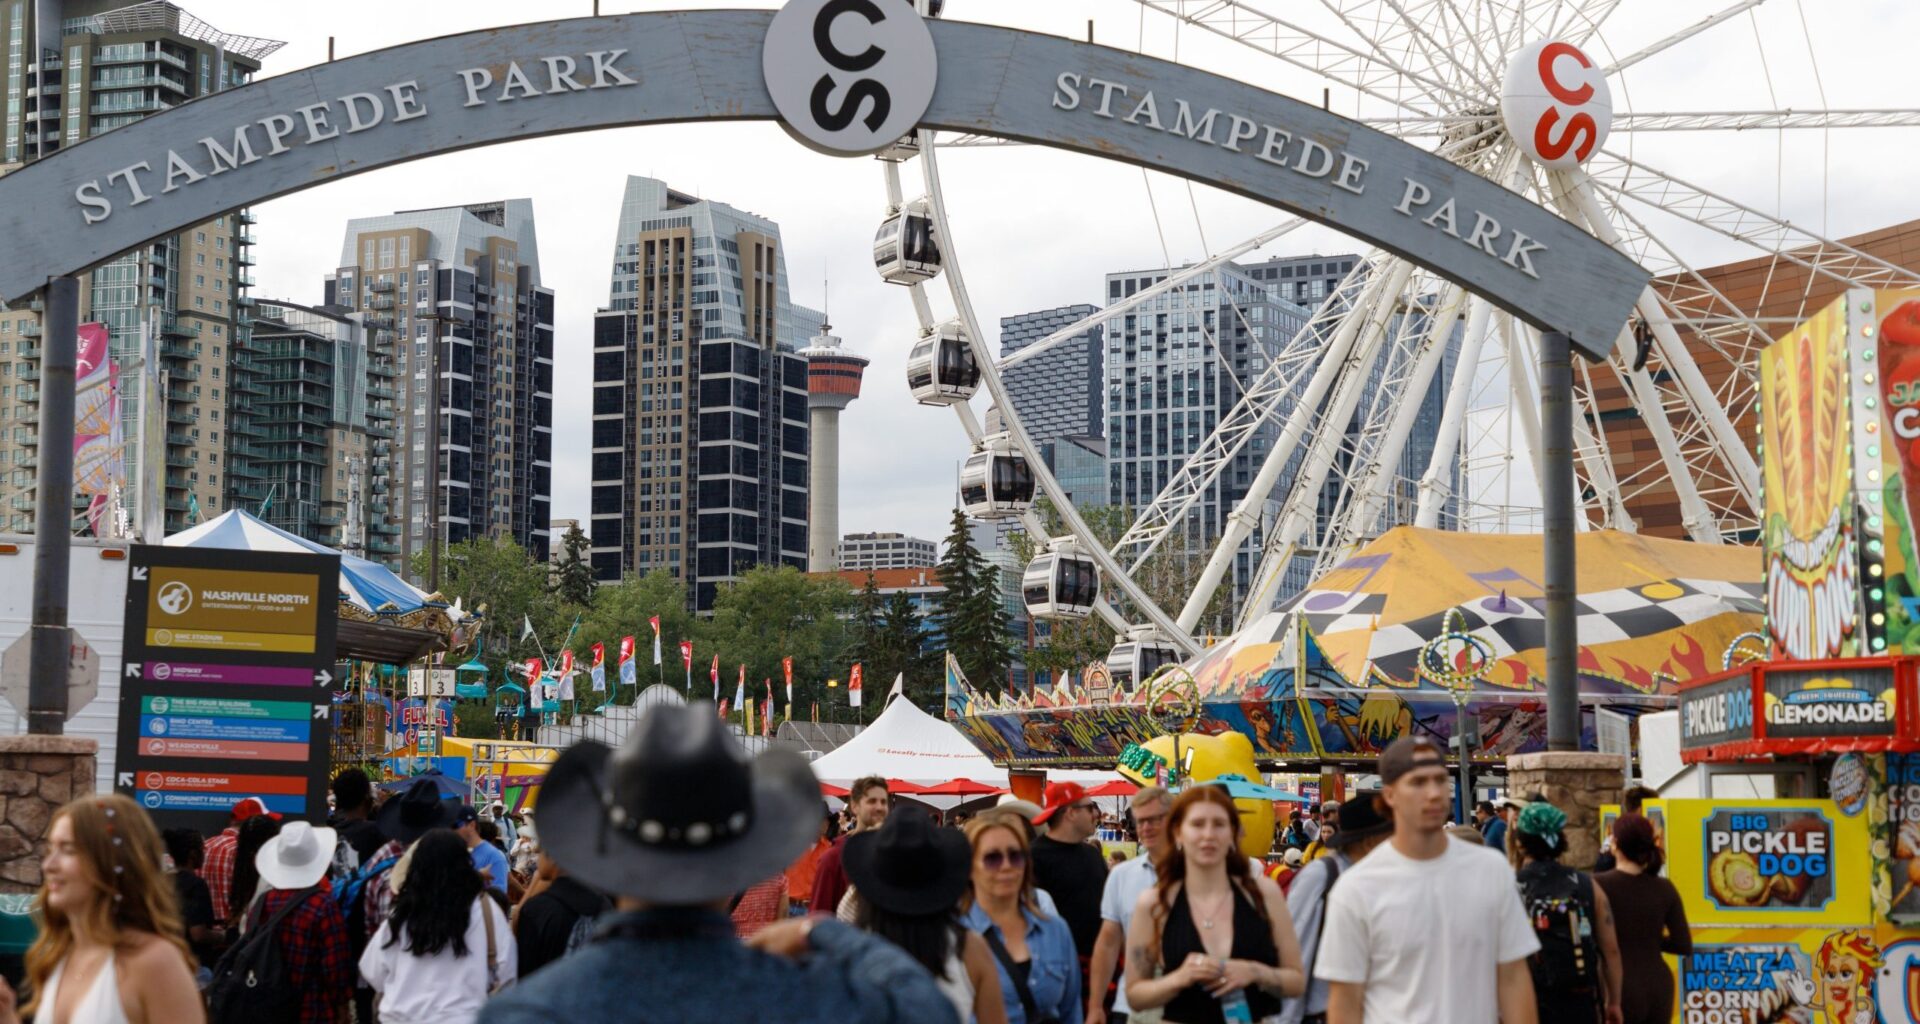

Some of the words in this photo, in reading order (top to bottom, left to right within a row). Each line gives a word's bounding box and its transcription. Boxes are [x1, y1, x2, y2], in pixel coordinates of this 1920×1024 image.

[74, 80, 427, 225] STAMPEDE
[456, 49, 639, 108] PARK
[1052, 71, 1371, 195] STAMPEDE
[1393, 177, 1549, 281] PARK
[202, 590, 266, 603] NASHVILLE
[268, 593, 310, 605] NORTH
[173, 666, 203, 674] MIDWAY
[413, 681, 419, 695] 3
[437, 681, 445, 695] 3
[171, 698, 185, 706] THE
[1688, 693, 1727, 737] PICKLE
[1728, 687, 1753, 731] DOG
[1773, 702, 1886, 725] LEMONADE
[187, 718, 213, 726] CENTRE
[165, 776, 207, 784] COCA-COLA
[164, 795, 208, 803] COMMUNITY
[209, 796, 228, 804] PARK
[1731, 813, 1768, 831] BIG
[1711, 831, 1826, 854] PICKLE
[1759, 854, 1827, 876] DOG
[1693, 953, 1796, 971] MEATZA
[1686, 971, 1777, 990] MOZZA
[1686, 991, 1761, 1009] CORN
[1686, 1009, 1743, 1024] DOG
